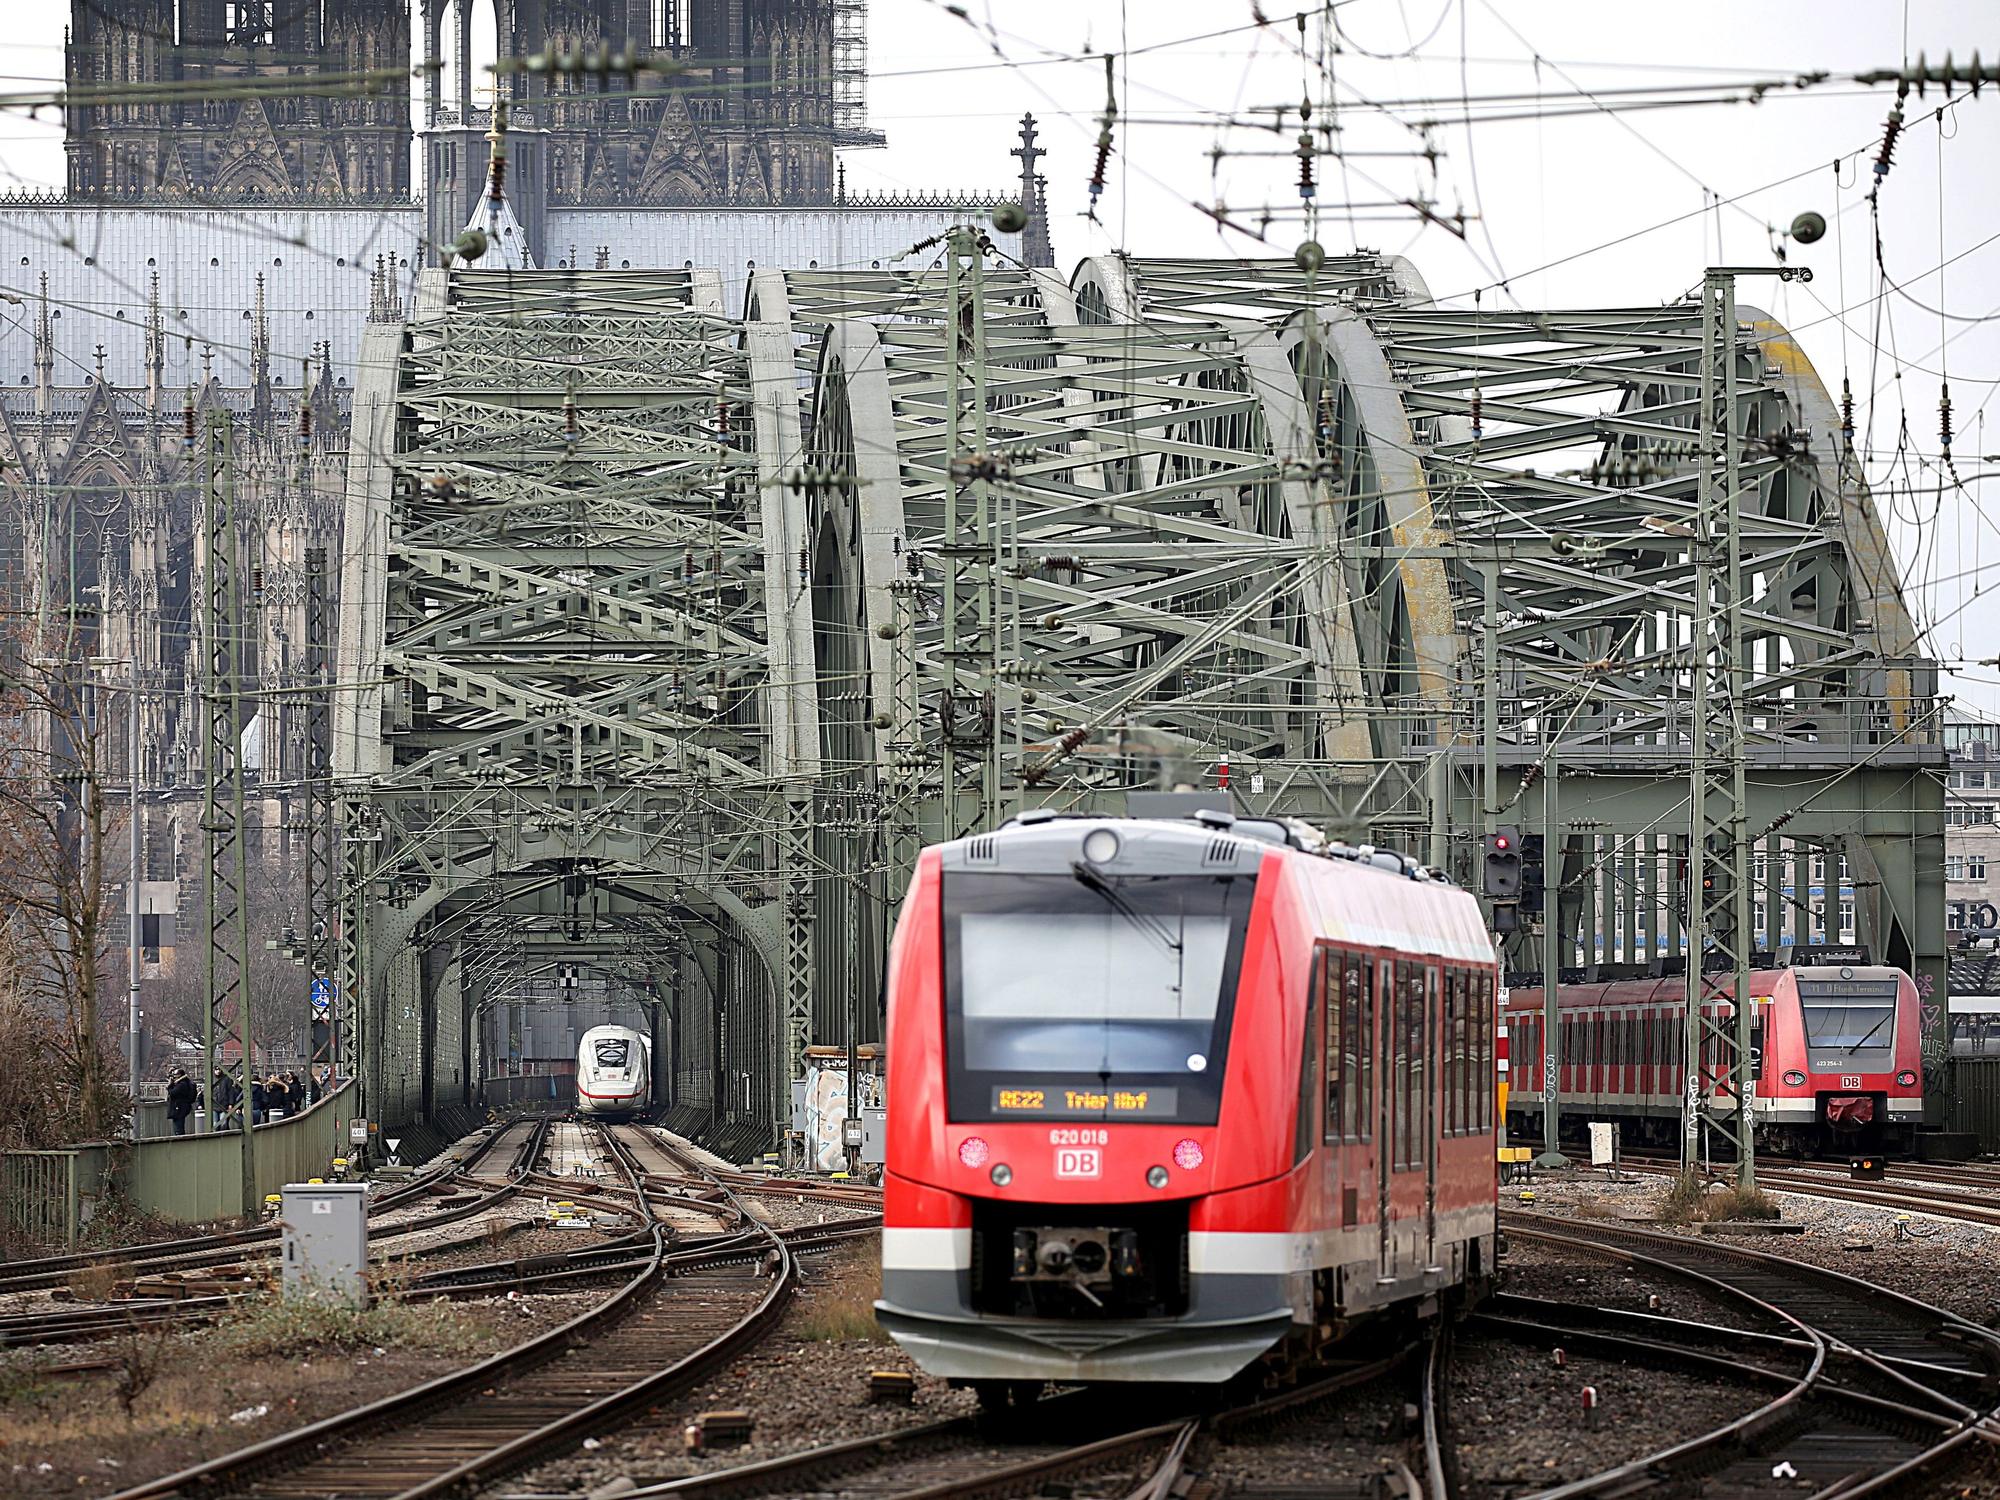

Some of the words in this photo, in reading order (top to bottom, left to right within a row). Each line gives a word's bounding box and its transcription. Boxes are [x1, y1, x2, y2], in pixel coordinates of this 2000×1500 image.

[1843, 1077, 1860, 1088] DB
[1000, 1090, 1044, 1108] RE22
[1065, 1091, 1108, 1109] Trier
[1113, 1091, 1148, 1109] Hbf
[1050, 1129, 1079, 1145] 620
[1080, 1129, 1108, 1145] 018
[1062, 1152, 1095, 1174] DB
